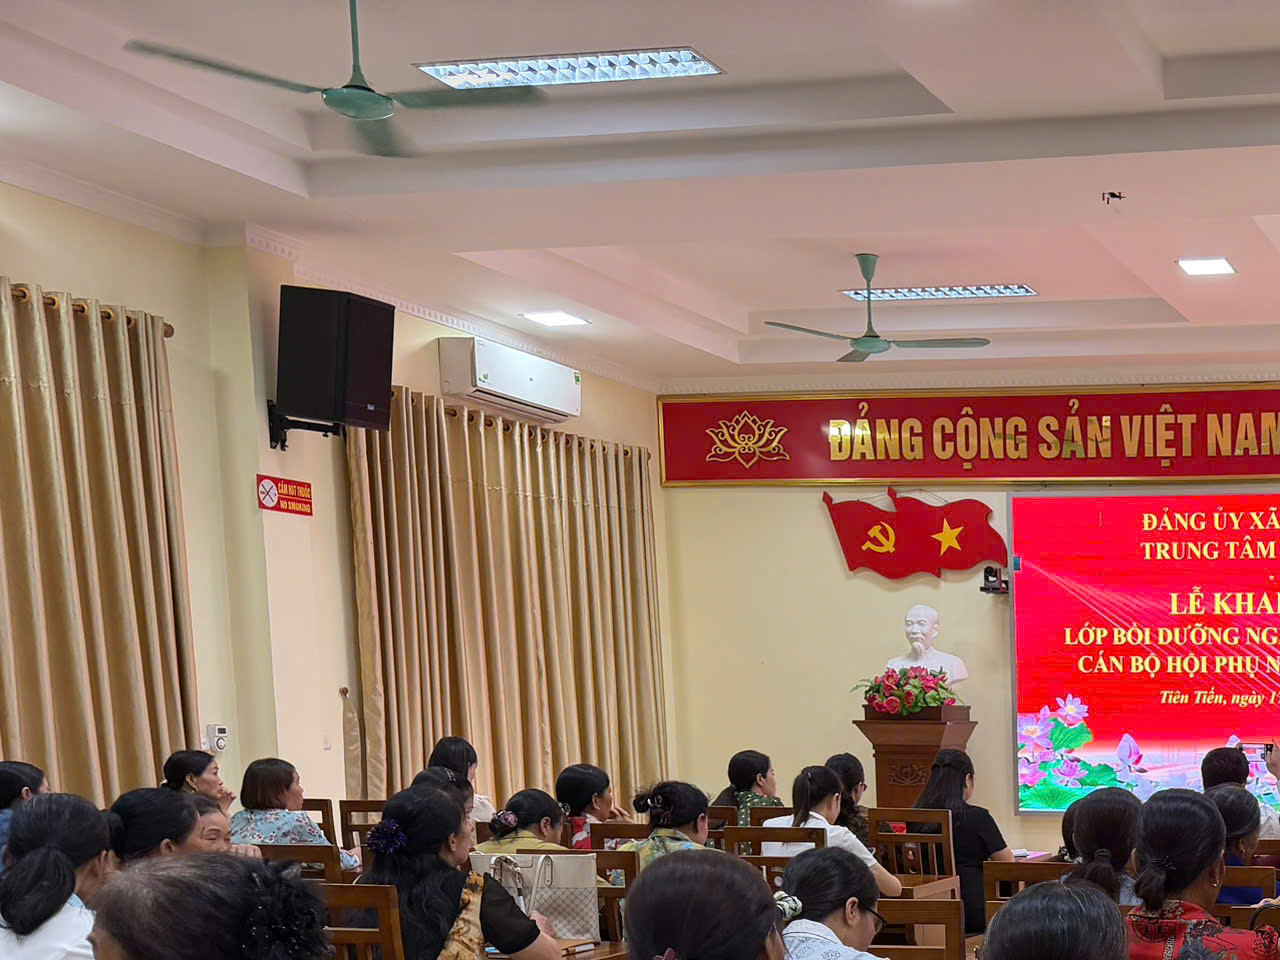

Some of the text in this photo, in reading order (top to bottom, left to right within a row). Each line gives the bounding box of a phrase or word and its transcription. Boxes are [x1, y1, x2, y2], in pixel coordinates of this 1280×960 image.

[829, 402, 923, 461] ĐẢNG
[934, 406, 1027, 469] CỘNG
[1038, 398, 1111, 459] SẢN
[1119, 403, 1197, 467] VIỆT
[1142, 507, 1206, 530] ĐẢNG
[1213, 506, 1244, 530] ỦY
[1250, 506, 1280, 529] XÃ
[1140, 540, 1219, 560] TRUNG
[1225, 535, 1277, 559] TÂM
[1169, 586, 1206, 615] LỄ
[1064, 622, 1108, 645] LỚP
[1158, 622, 1239, 645] DƯỠNG
[1078, 650, 1124, 673] CÁN
[1131, 652, 1161, 678] BỘ
[1167, 652, 1208, 678] HỘI
[1215, 655, 1259, 678] PHỤ
[1160, 690, 1189, 704] Tiên
[1231, 690, 1265, 708] ngày
